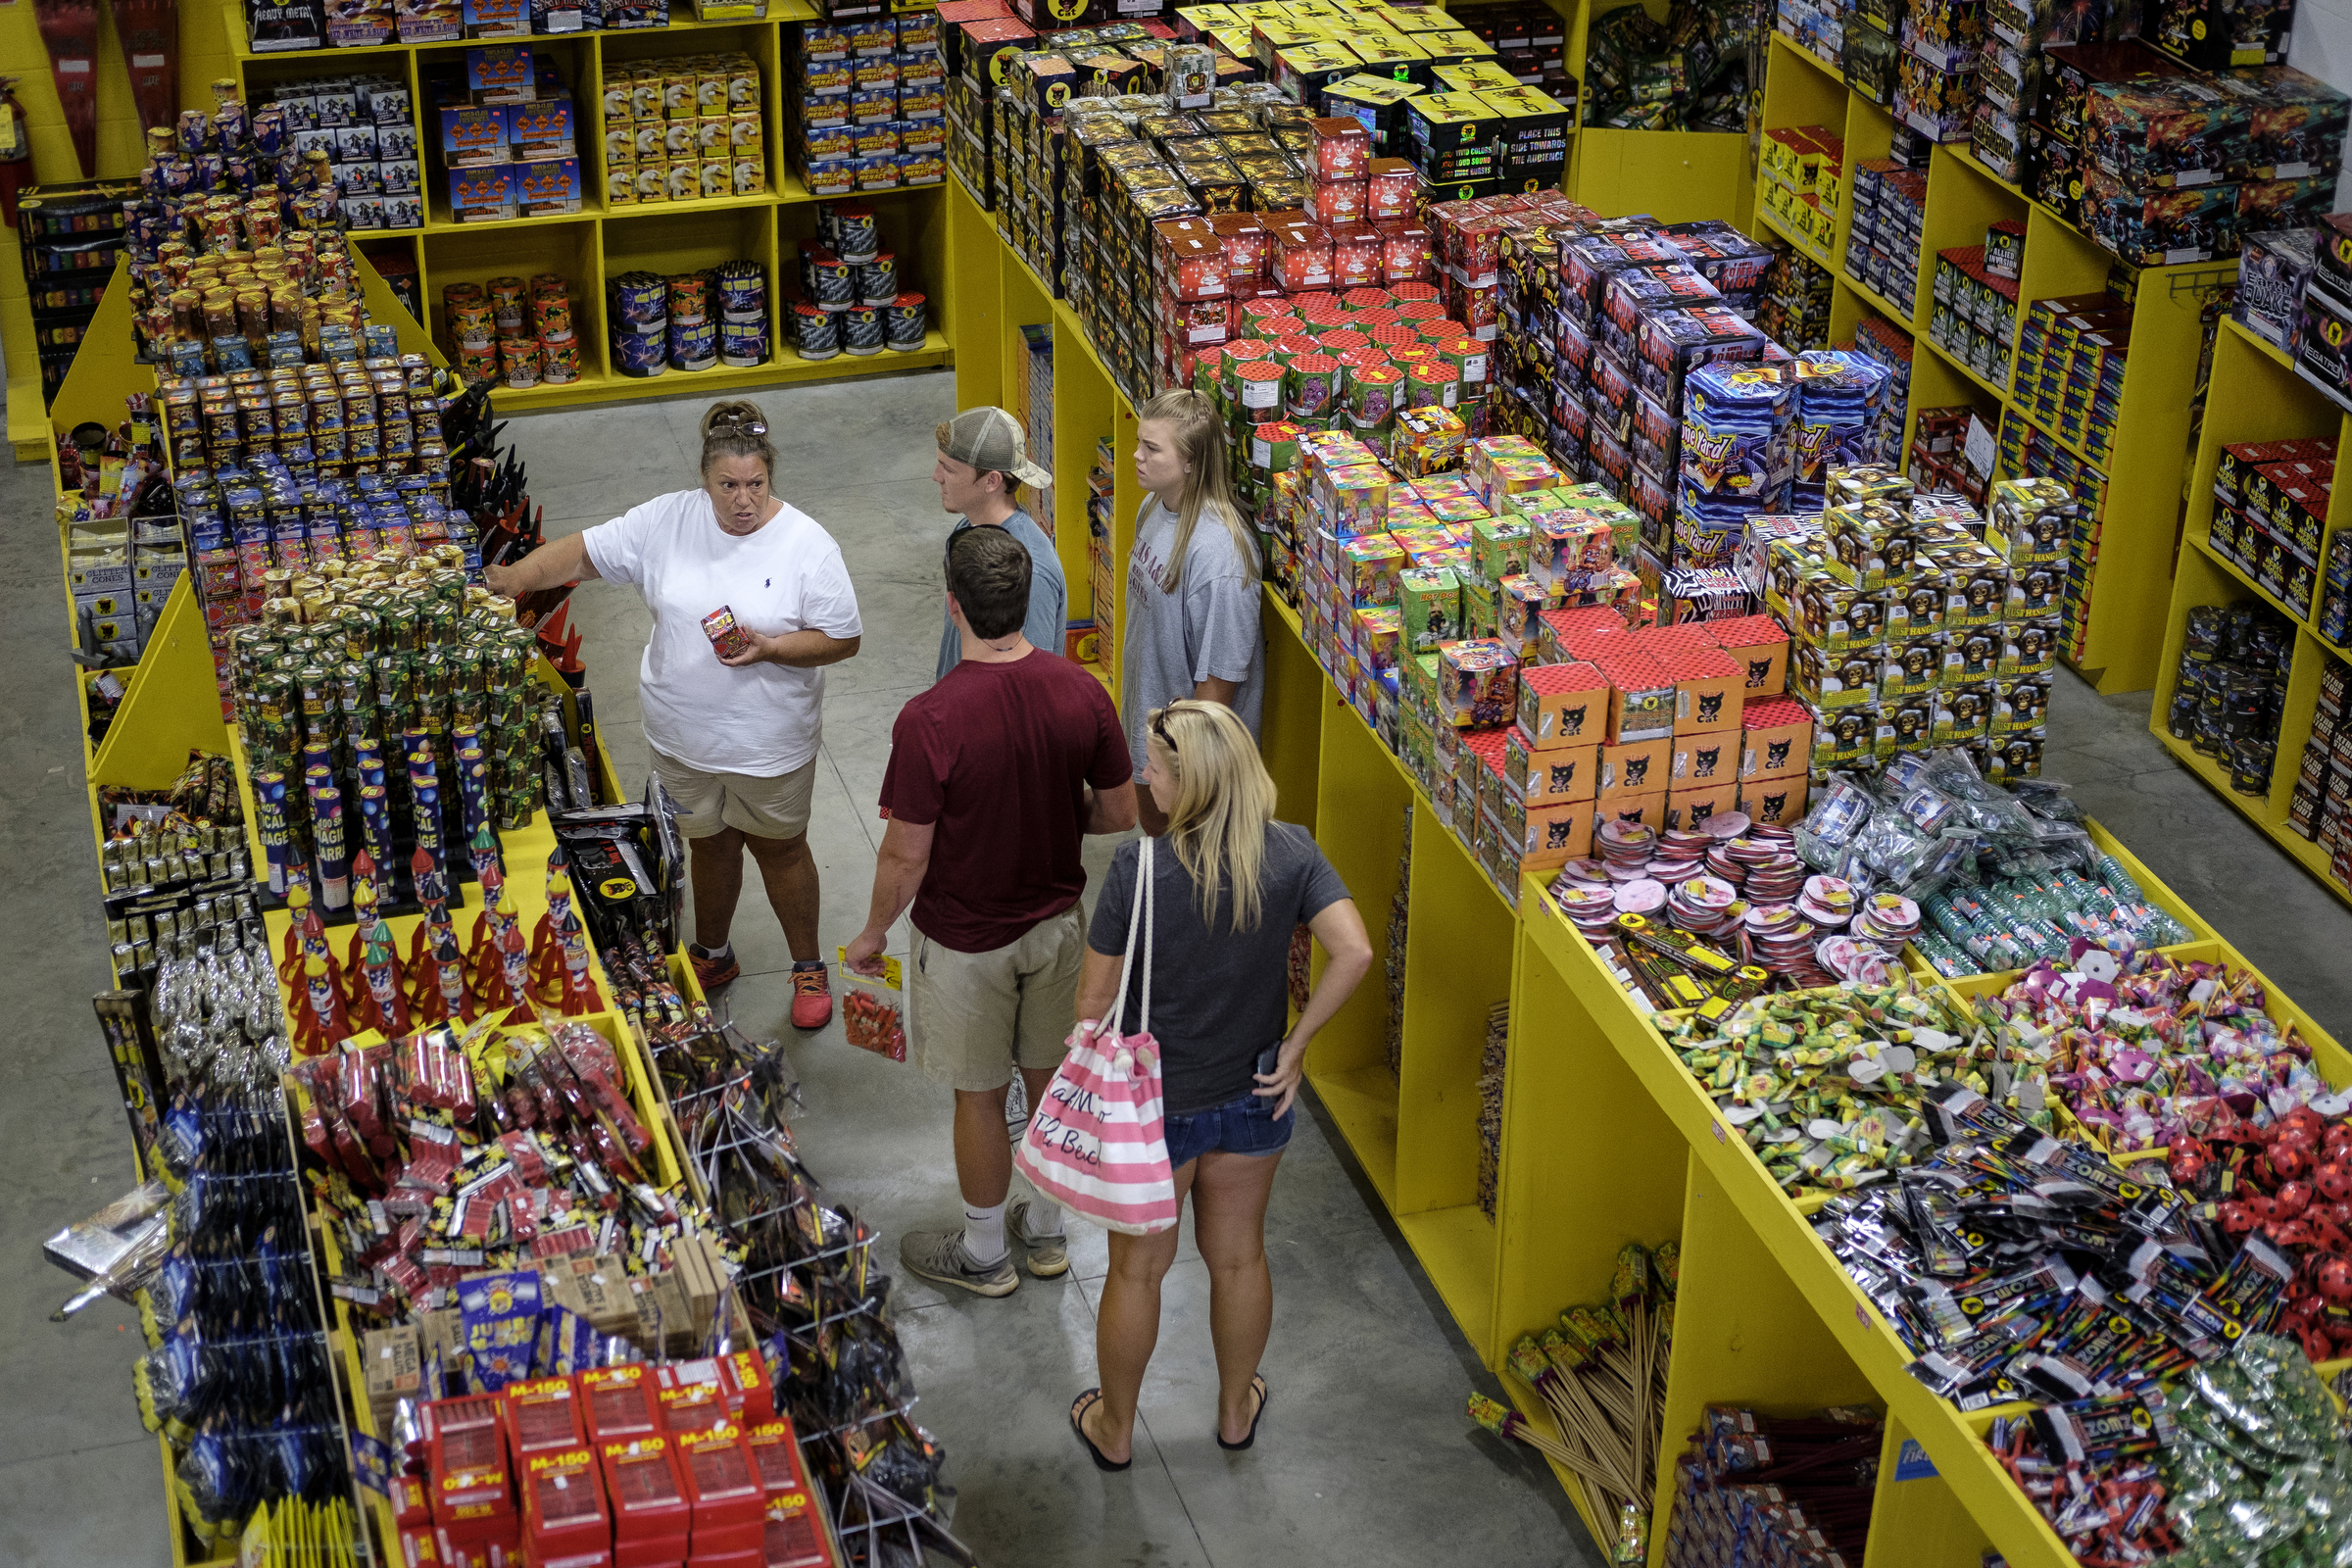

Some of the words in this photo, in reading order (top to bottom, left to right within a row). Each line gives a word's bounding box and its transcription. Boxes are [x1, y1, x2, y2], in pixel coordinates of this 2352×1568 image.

[256, 9, 283, 22] HEAVY
[285, 7, 312, 21] METAL
[1056, 8, 1078, 18] Cat
[853, 38, 882, 47] MENACE
[854, 31, 880, 41] MOBILE
[810, 73, 837, 81] MOBILE
[857, 67, 883, 75] MOBILE
[857, 73, 885, 81] MENACE
[903, 70, 931, 78] MENACE
[809, 78, 839, 87] MENACE
[904, 135, 931, 144] MENACE
[1518, 129, 1542, 140] PLACE
[1544, 126, 1561, 137] THIS
[1455, 148, 1470, 157] VIVID
[1470, 145, 1493, 156] COLORS
[1510, 141, 1528, 153] SIDE
[1529, 138, 1567, 152] TOWARDS
[1455, 158, 1470, 167] LOUD
[1471, 156, 1492, 165] SOUND
[1511, 154, 1526, 165] THE
[1527, 150, 1565, 164] AUDIENCE
[1992, 247, 2015, 260] ALLIED
[1988, 254, 2018, 269] INVASION
[1723, 264, 1765, 278] ZOMBIE
[2312, 254, 2352, 298] MEGATRO
[1713, 275, 1757, 292] ATION
[2247, 271, 2292, 297] Earth
[2242, 283, 2293, 316] QUAKE
[2035, 311, 2048, 323] SHOTS
[2062, 327, 2074, 340] SHOTS
[1639, 337, 1670, 372] NATION
[1710, 349, 1756, 362] ZOMBIE
[2083, 344, 2097, 358] SHOTS
[2298, 332, 2350, 385] MEGATRON
[1592, 368, 1623, 410] NATION
[2074, 387, 2087, 400] SHOTS
[1634, 412, 1666, 451] NATION
[1696, 430, 1731, 461] Yard
[2218, 465, 2237, 483] REBEL
[1630, 484, 1663, 523] NATION
[1614, 525, 1633, 534] DOG
[2297, 526, 2317, 546] REBEL
[1497, 542, 1514, 551] HOT
[1515, 540, 1530, 550] DO
[1689, 523, 1725, 556] Yard
[2017, 553, 2034, 564] JUST
[85, 566, 128, 578] GLITTER
[151, 564, 186, 573] GLITTE
[91, 574, 124, 584] CONES
[1420, 593, 1438, 602] HOT
[1440, 591, 1459, 600] DOG
[1711, 607, 1744, 620] ZEBRA
[2002, 662, 2019, 674] JUST
[1744, 678, 1765, 689] Cat
[1696, 713, 1719, 724] Cat
[1995, 718, 2012, 731] JUST
[1559, 727, 1583, 738] Cat
[1819, 749, 1836, 761] JUST
[1764, 759, 1786, 769] Cat
[1693, 767, 1715, 778] Cat
[1623, 776, 1644, 788] Cat
[1548, 784, 1571, 795] Cat
[510, 1379, 568, 1398] M-150
[746, 1421, 785, 1437] -150
[606, 1437, 665, 1457] M-50
[530, 1450, 591, 1472] M-150
